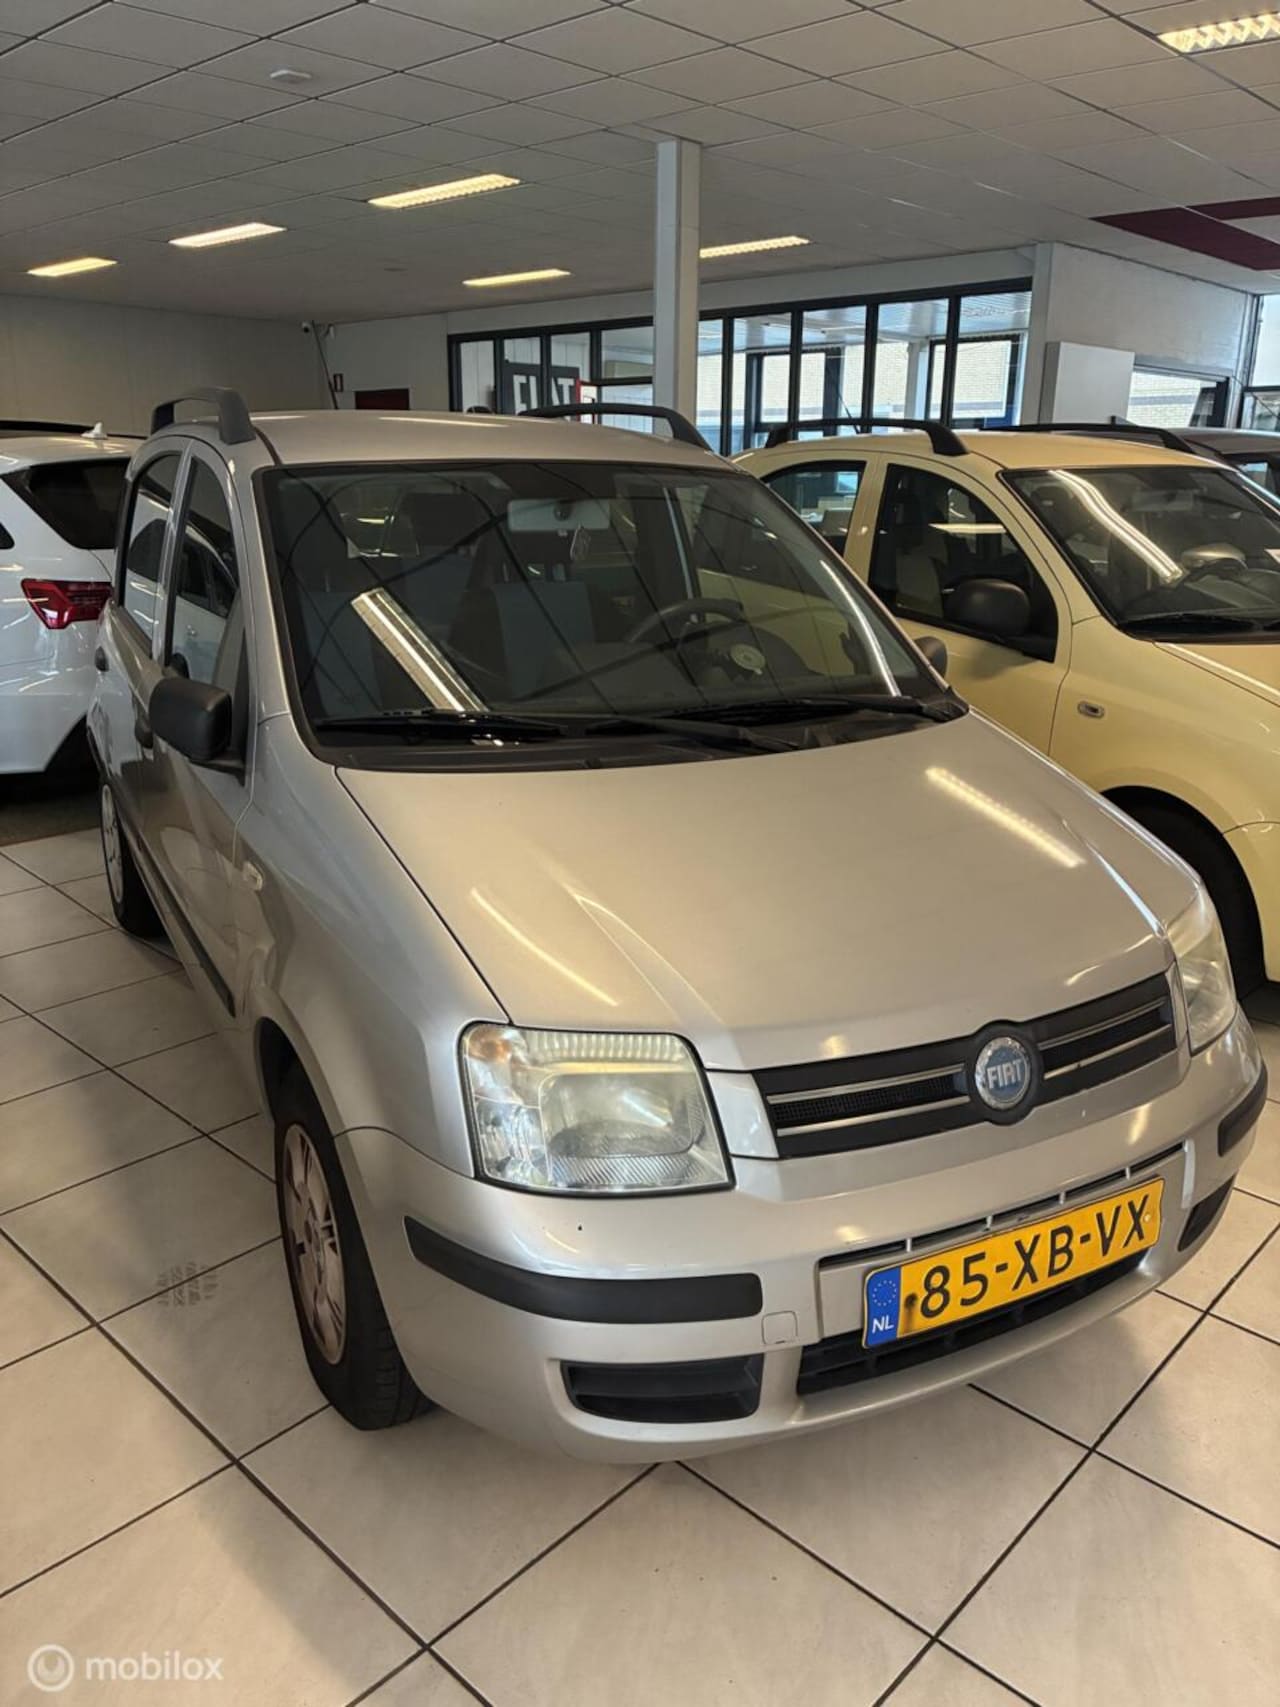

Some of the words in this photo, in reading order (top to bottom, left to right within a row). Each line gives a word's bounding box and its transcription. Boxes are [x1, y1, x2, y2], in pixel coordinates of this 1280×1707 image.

[987, 1059, 1021, 1089] FIAT
[920, 1194, 1149, 1319] 85-XB-VX
[872, 1315, 894, 1333] NL
